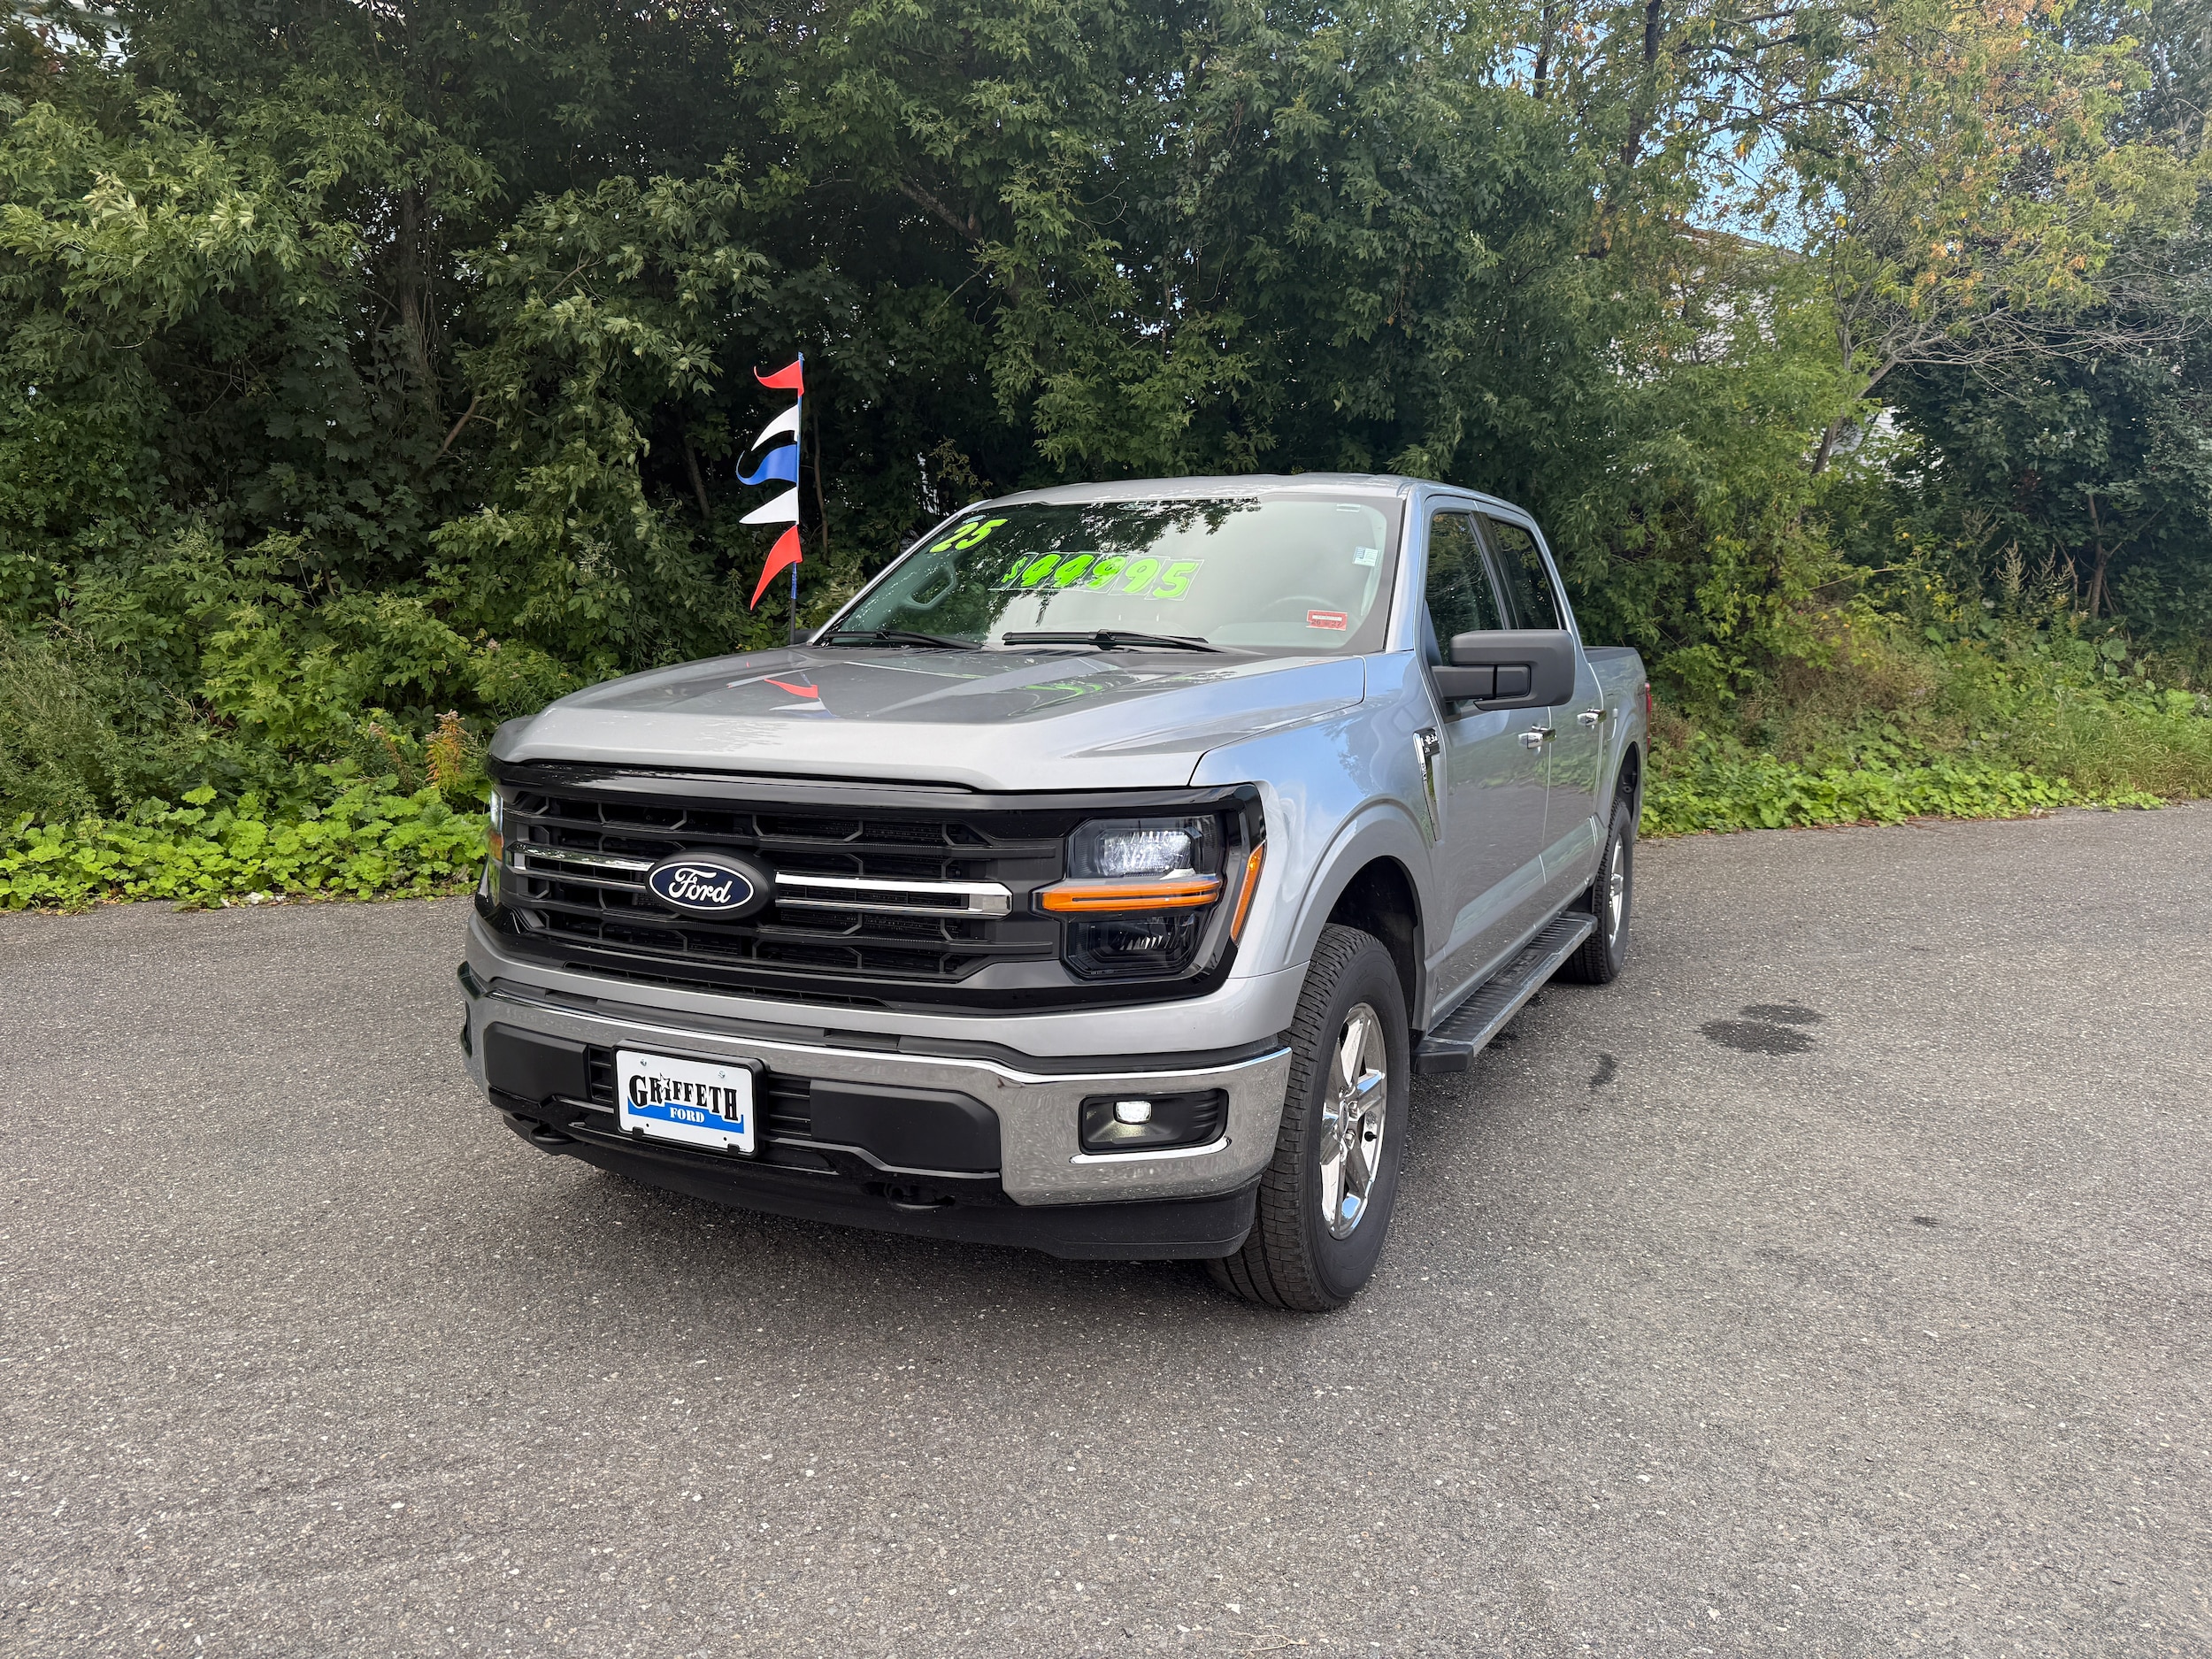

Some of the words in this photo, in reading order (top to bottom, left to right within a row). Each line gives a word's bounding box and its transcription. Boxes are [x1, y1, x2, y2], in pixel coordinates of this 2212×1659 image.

[929, 518, 1008, 550] 25
[1001, 554, 1199, 599] $44995
[668, 867, 733, 903] Ford
[628, 1074, 739, 1121] GRIFFETH
[670, 1107, 705, 1123] FORD
